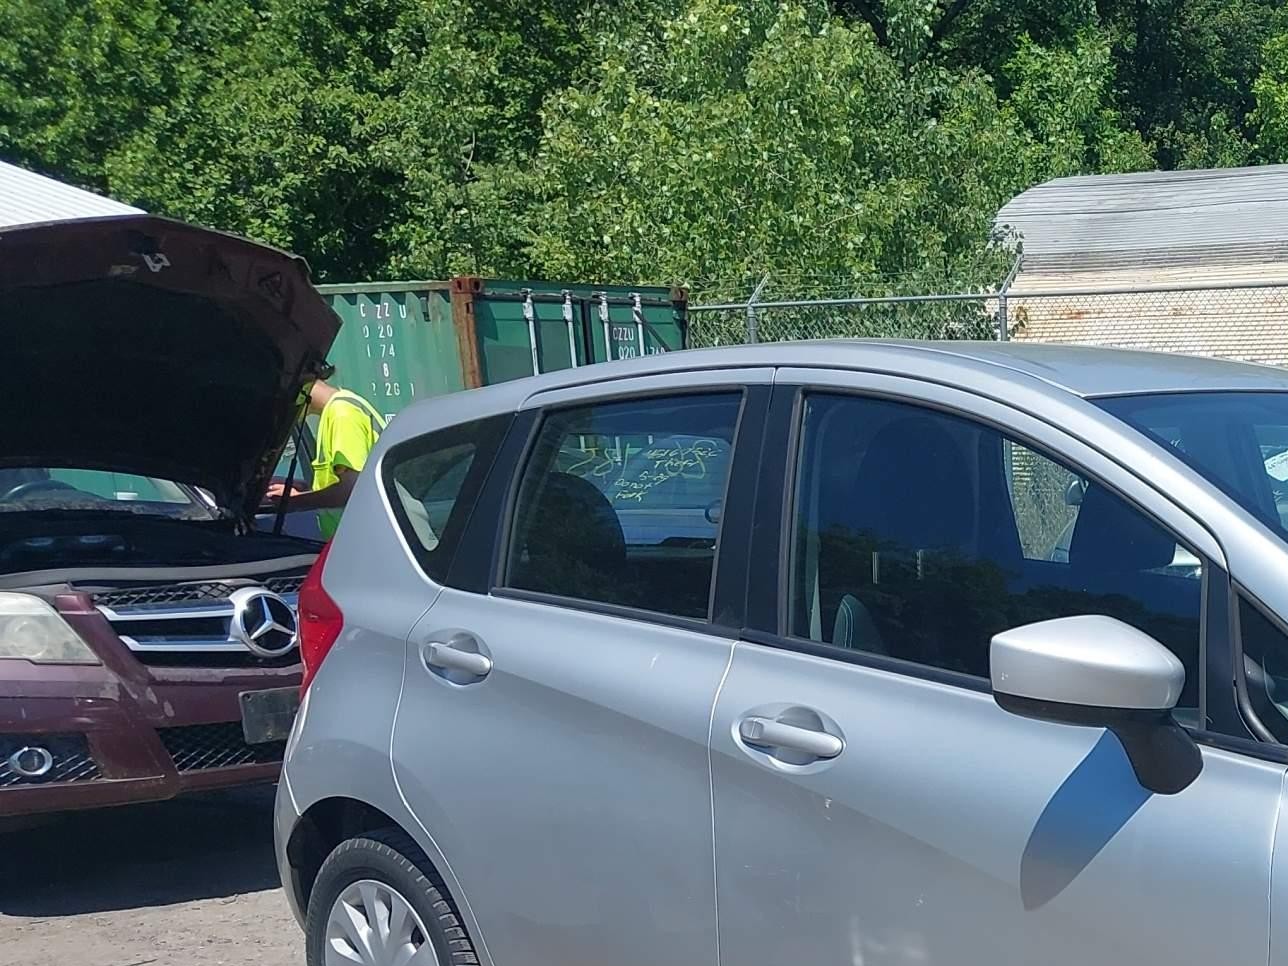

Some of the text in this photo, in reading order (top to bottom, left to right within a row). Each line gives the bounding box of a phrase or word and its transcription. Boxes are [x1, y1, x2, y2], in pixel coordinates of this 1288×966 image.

[612, 327, 634, 341] CZZU
[618, 346, 636, 360] 020
[383, 363, 390, 377] 8
